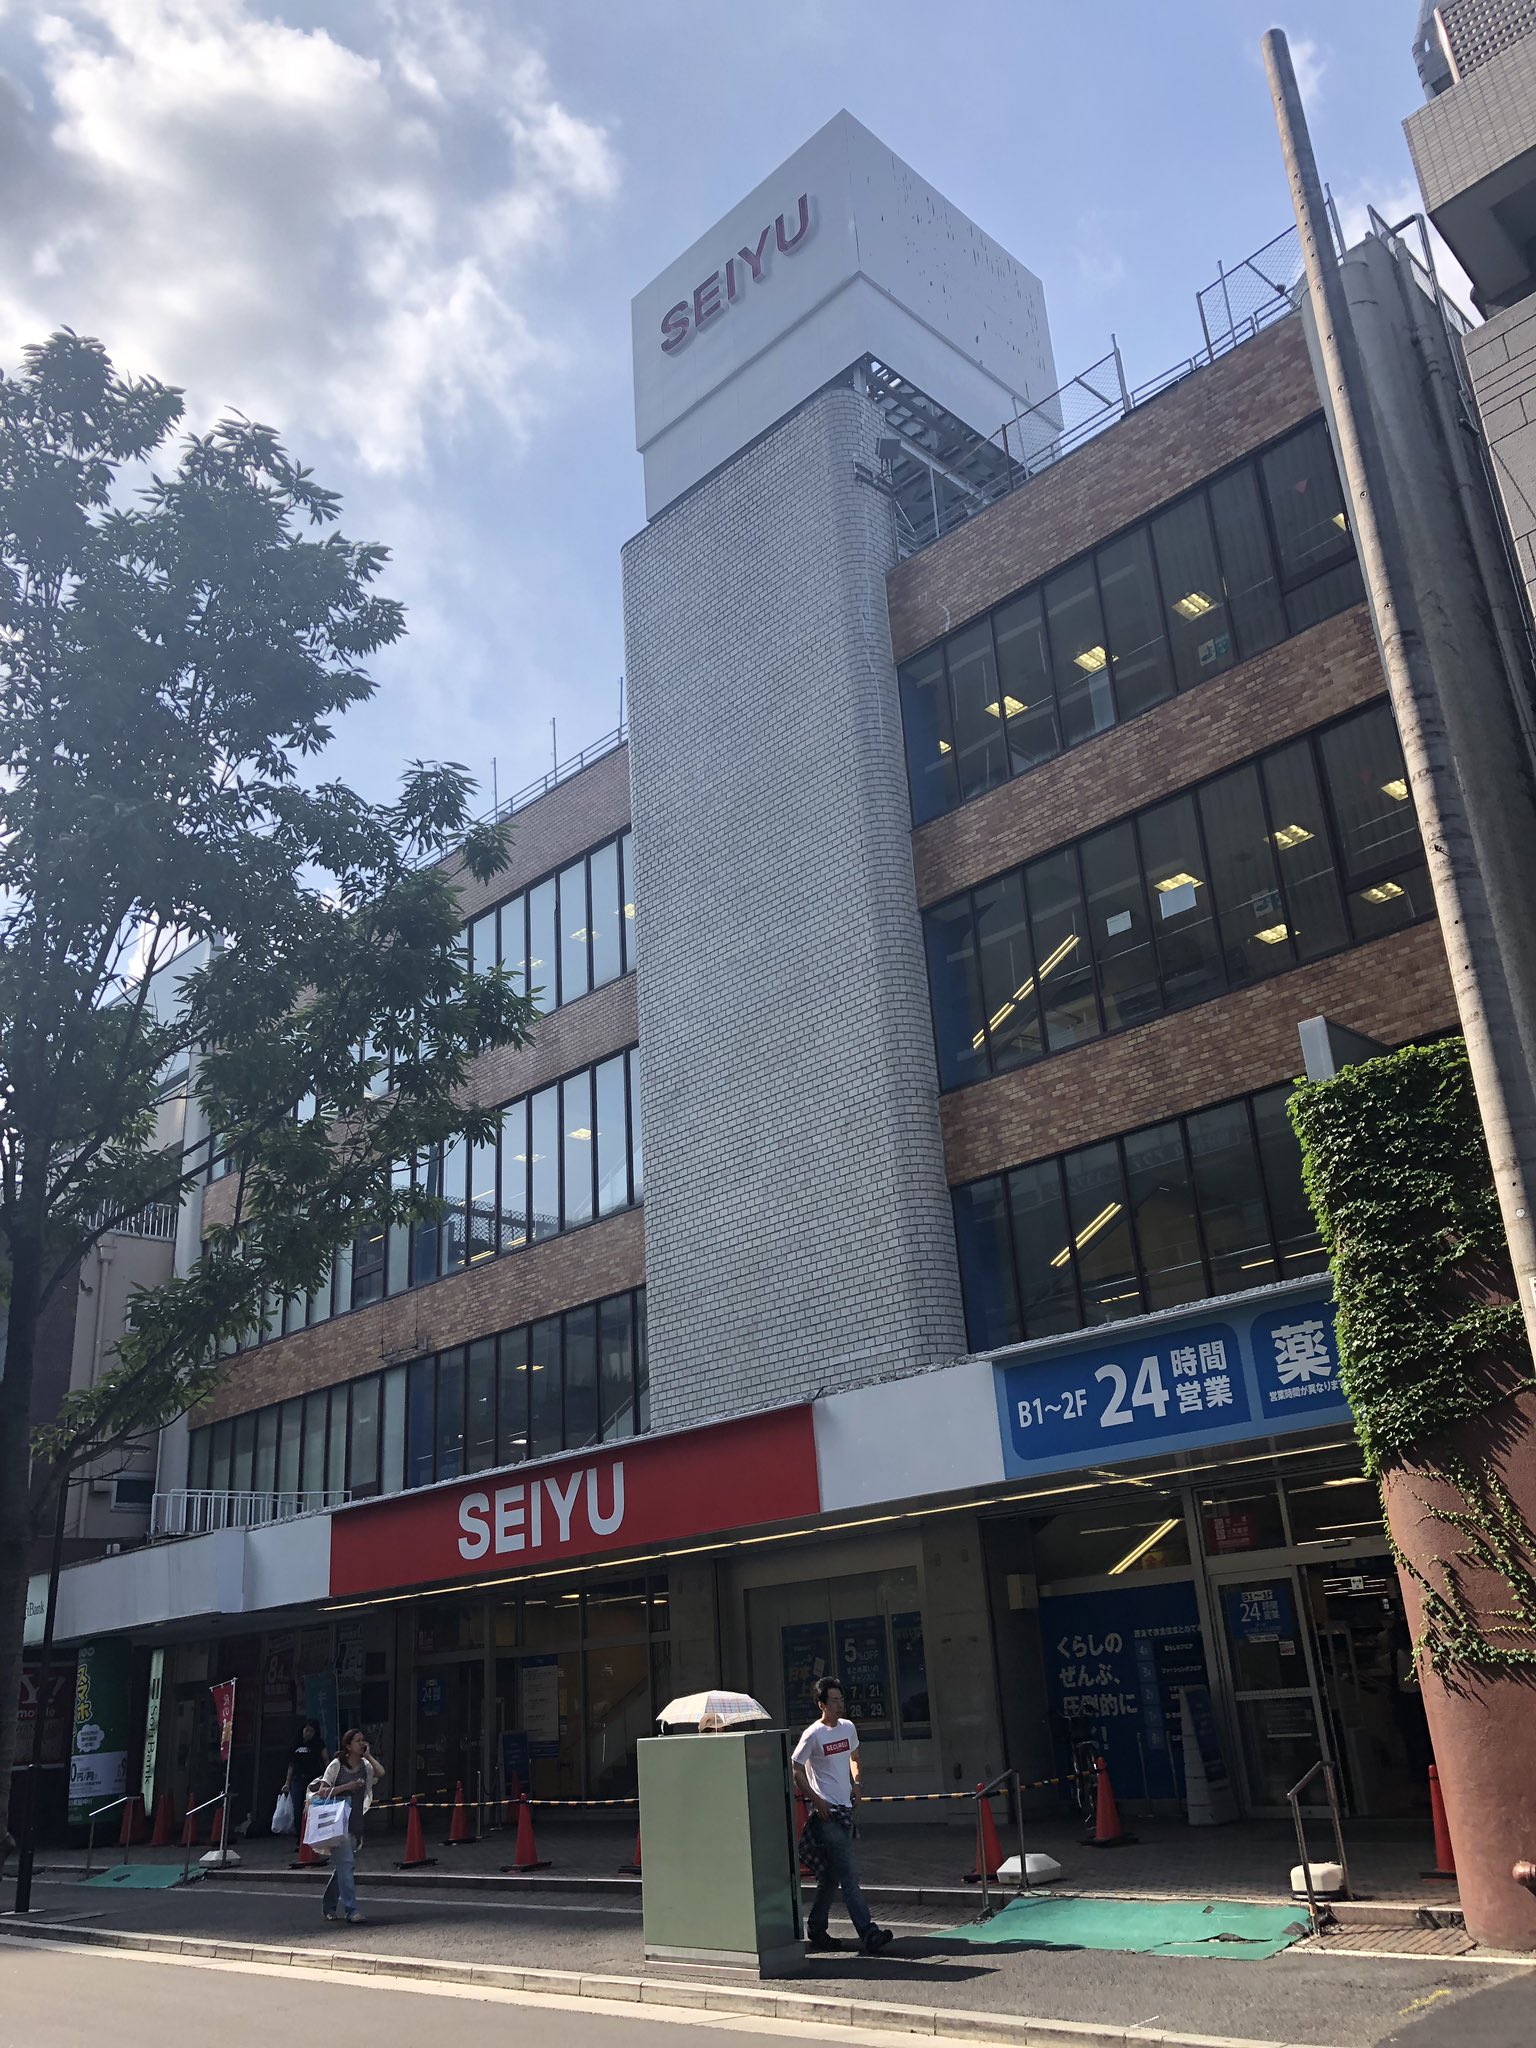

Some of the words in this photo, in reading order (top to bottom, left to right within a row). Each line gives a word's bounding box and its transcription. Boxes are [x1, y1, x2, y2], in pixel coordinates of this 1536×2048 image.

[661, 193, 810, 354] SEIYU
[1170, 1340, 1228, 1377] 時間
[1095, 1355, 1169, 1427] 24
[1176, 1375, 1233, 1414] 営業
[1269, 1379, 1343, 1402] 営業時間が異なりま
[458, 1462, 625, 1560] SEIYU
[1240, 1602, 1260, 1622] 24
[1057, 1632, 1123, 1658] くらしの
[1059, 1663, 1121, 1688] ぜんぶ、
